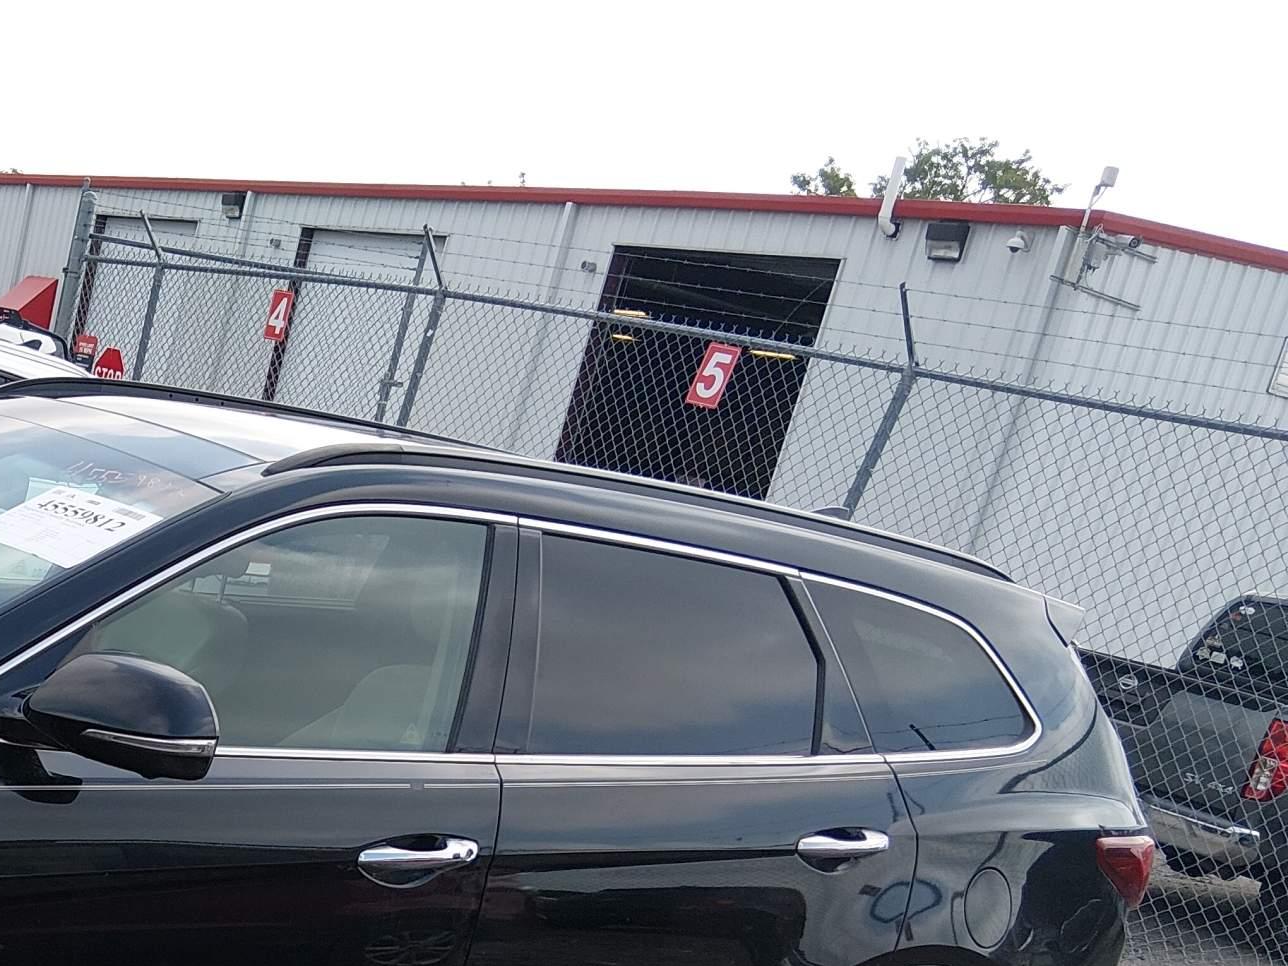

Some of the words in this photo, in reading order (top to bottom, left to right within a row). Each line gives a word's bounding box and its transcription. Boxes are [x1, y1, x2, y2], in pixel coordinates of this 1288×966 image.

[268, 297, 288, 335] 4
[696, 352, 732, 399] 5
[37, 499, 127, 532] 45559812
